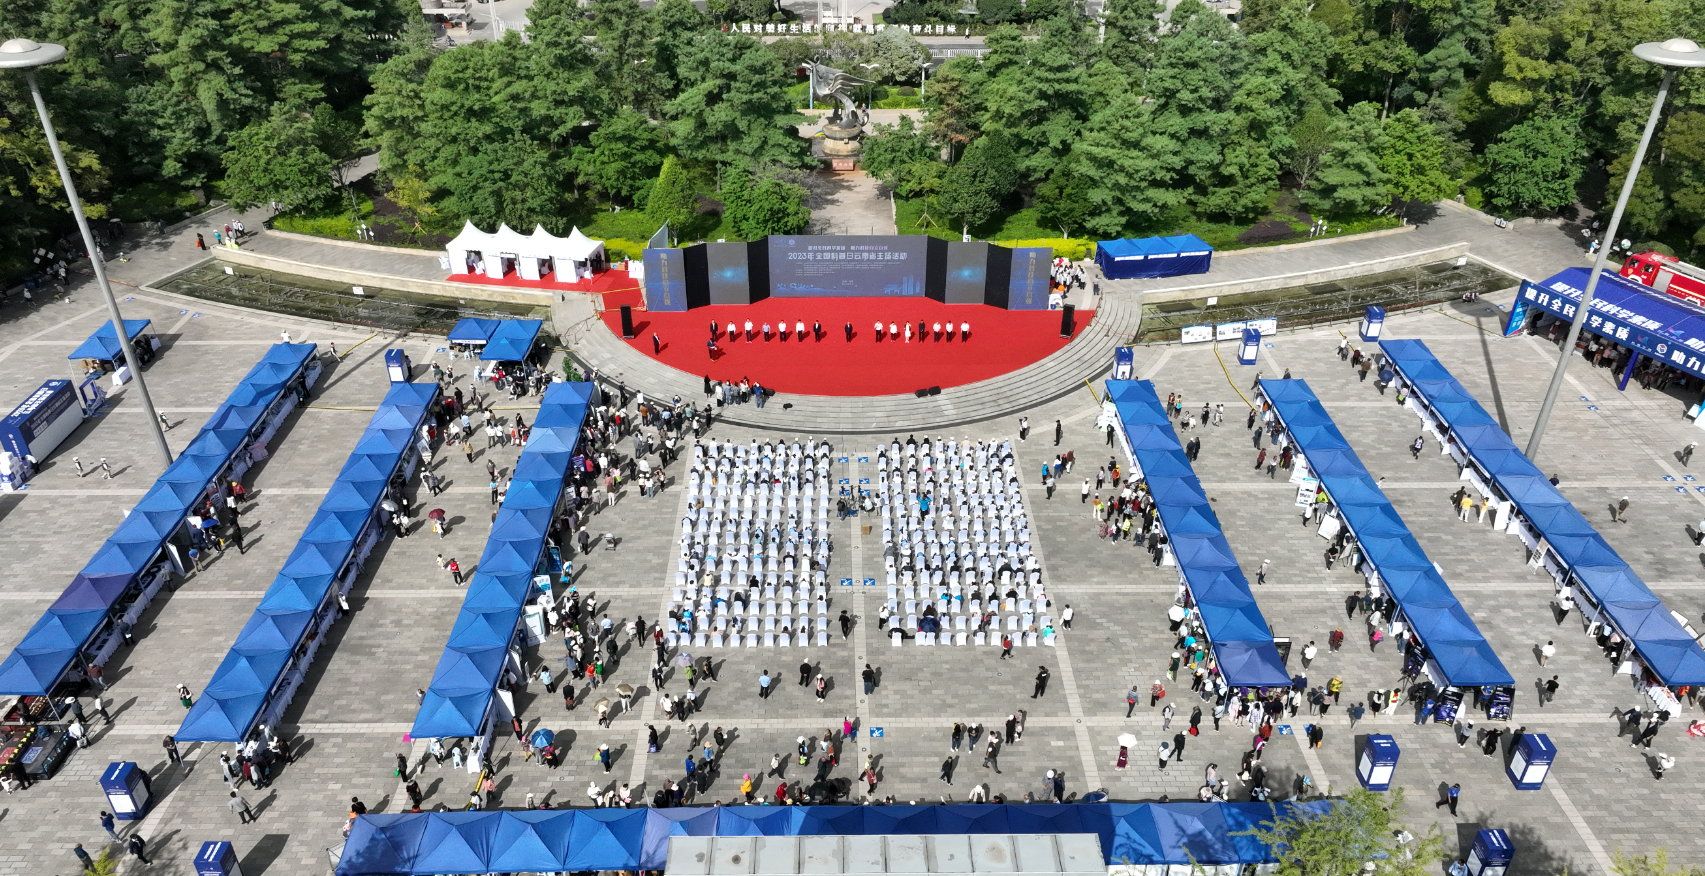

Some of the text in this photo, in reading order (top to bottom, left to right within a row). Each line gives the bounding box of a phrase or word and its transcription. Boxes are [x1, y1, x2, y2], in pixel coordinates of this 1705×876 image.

[788, 252, 908, 261] 2023年全国科普日云南省主场活动
[1524, 287, 1630, 341] 提升全民学素质
